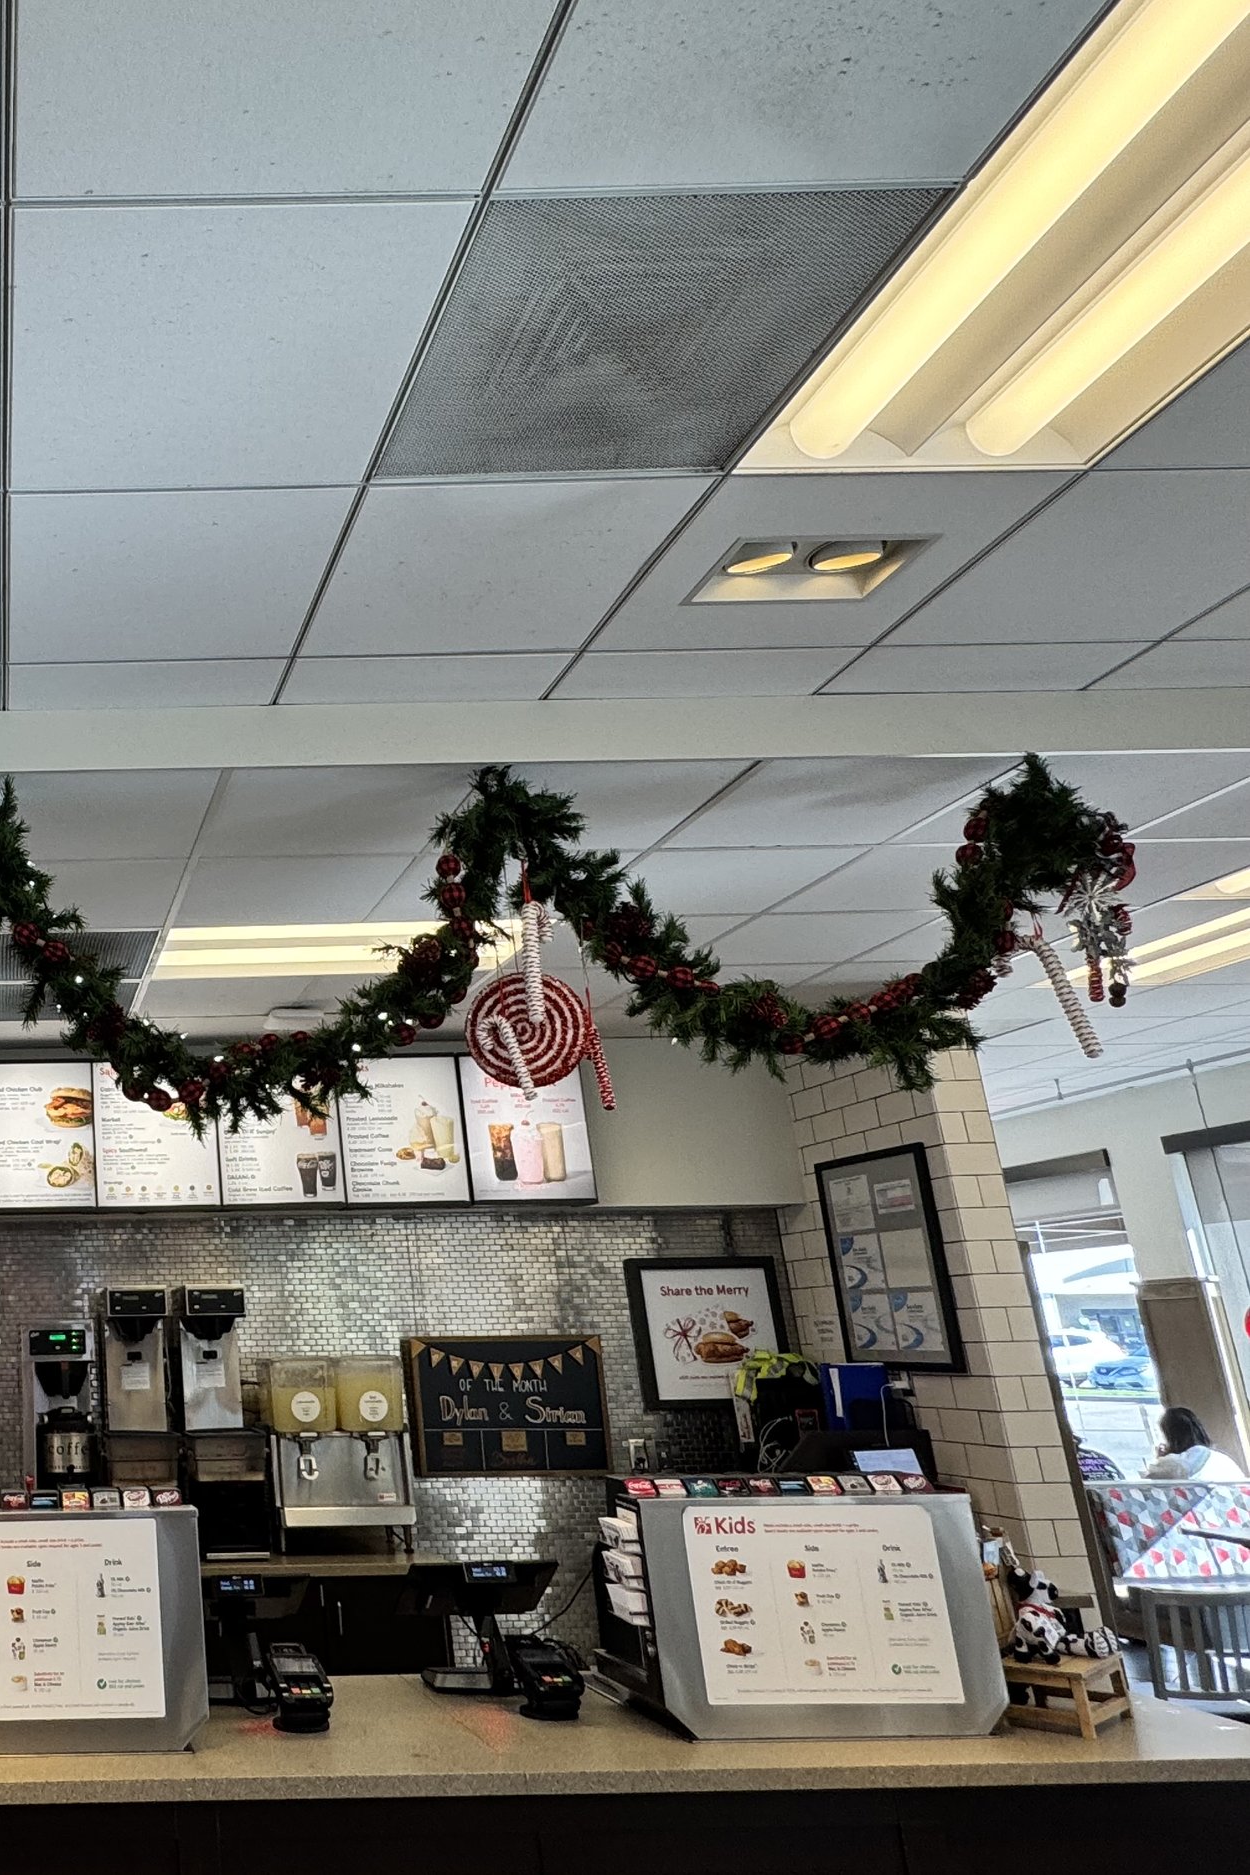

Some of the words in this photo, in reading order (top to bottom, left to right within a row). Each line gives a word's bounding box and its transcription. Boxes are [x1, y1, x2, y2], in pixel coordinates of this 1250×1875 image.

[660, 1285, 692, 1297] Share
[694, 1285, 714, 1296] the
[716, 1284, 749, 1297] Merry
[459, 1378, 473, 1392] OF
[483, 1378, 505, 1392] THE
[512, 1378, 548, 1393] MONTH
[439, 1395, 489, 1427] Dylan
[499, 1401, 514, 1421] &
[714, 1516, 756, 1534] Kids
[882, 1544, 901, 1552] Drink
[26, 1560, 42, 1568] Side
[104, 1558, 123, 1567] Drink
